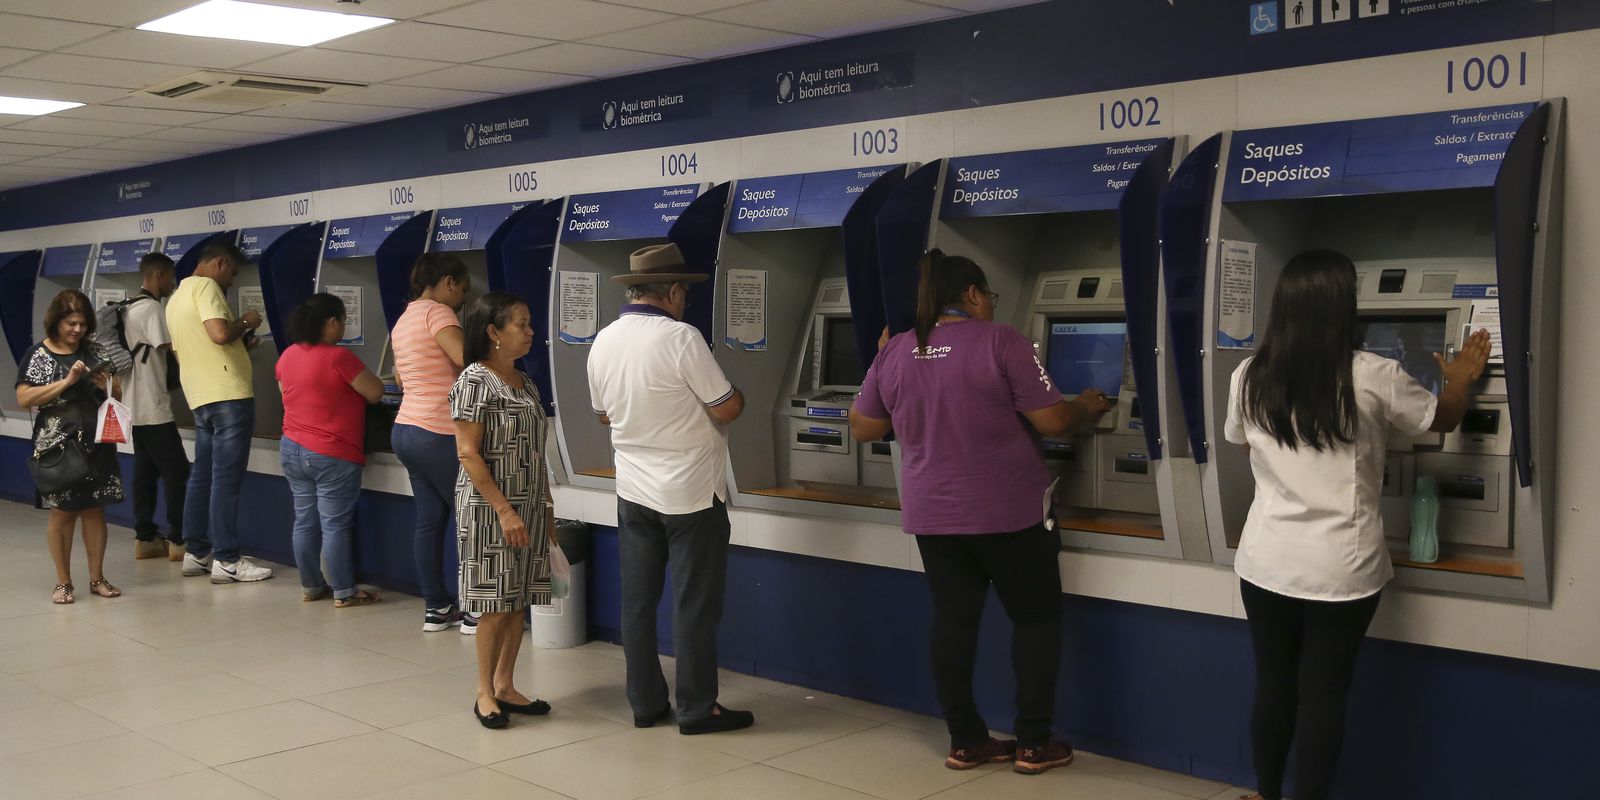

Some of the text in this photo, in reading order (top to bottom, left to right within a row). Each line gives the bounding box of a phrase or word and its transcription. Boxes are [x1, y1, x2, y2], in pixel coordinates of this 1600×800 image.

[1407, 3, 1436, 15] pessoas
[1437, 0, 1455, 8] com
[799, 62, 879, 85] Aqui tem leitura
[1447, 52, 1527, 93] 1001
[799, 82, 851, 99] biométrica
[620, 94, 684, 114] Aqui tem leitura
[620, 111, 662, 126] biométrica
[1100, 96, 1160, 131] 1002
[1450, 110, 1525, 124] Transferências
[479, 118, 529, 135] Aqui tem leitura
[479, 132, 512, 146] biométrica
[852, 128, 899, 156] 1003
[1434, 133, 1467, 145] Saldos
[1477, 131, 1517, 142] Extrato
[1244, 142, 1303, 162] Saques
[661, 152, 698, 177] 1004
[1092, 163, 1116, 172] Saldos
[508, 171, 538, 193] 1005
[957, 167, 1001, 185] Saques
[1240, 164, 1331, 187] Depósitos
[389, 185, 414, 206] 1006
[742, 188, 776, 203] Saques
[953, 187, 1019, 206] Depósitos
[289, 198, 309, 217] 1007
[572, 203, 600, 217] Saques
[738, 206, 789, 222] Depósitos
[139, 218, 154, 233] 1009
[208, 209, 226, 226] 1008
[440, 216, 462, 229] Saques
[331, 226, 350, 238] Saques
[569, 219, 610, 234] Depósitos
[436, 231, 469, 244] Depósitos
[328, 240, 356, 252] Depósitos
[911, 345, 952, 355] AENTO
